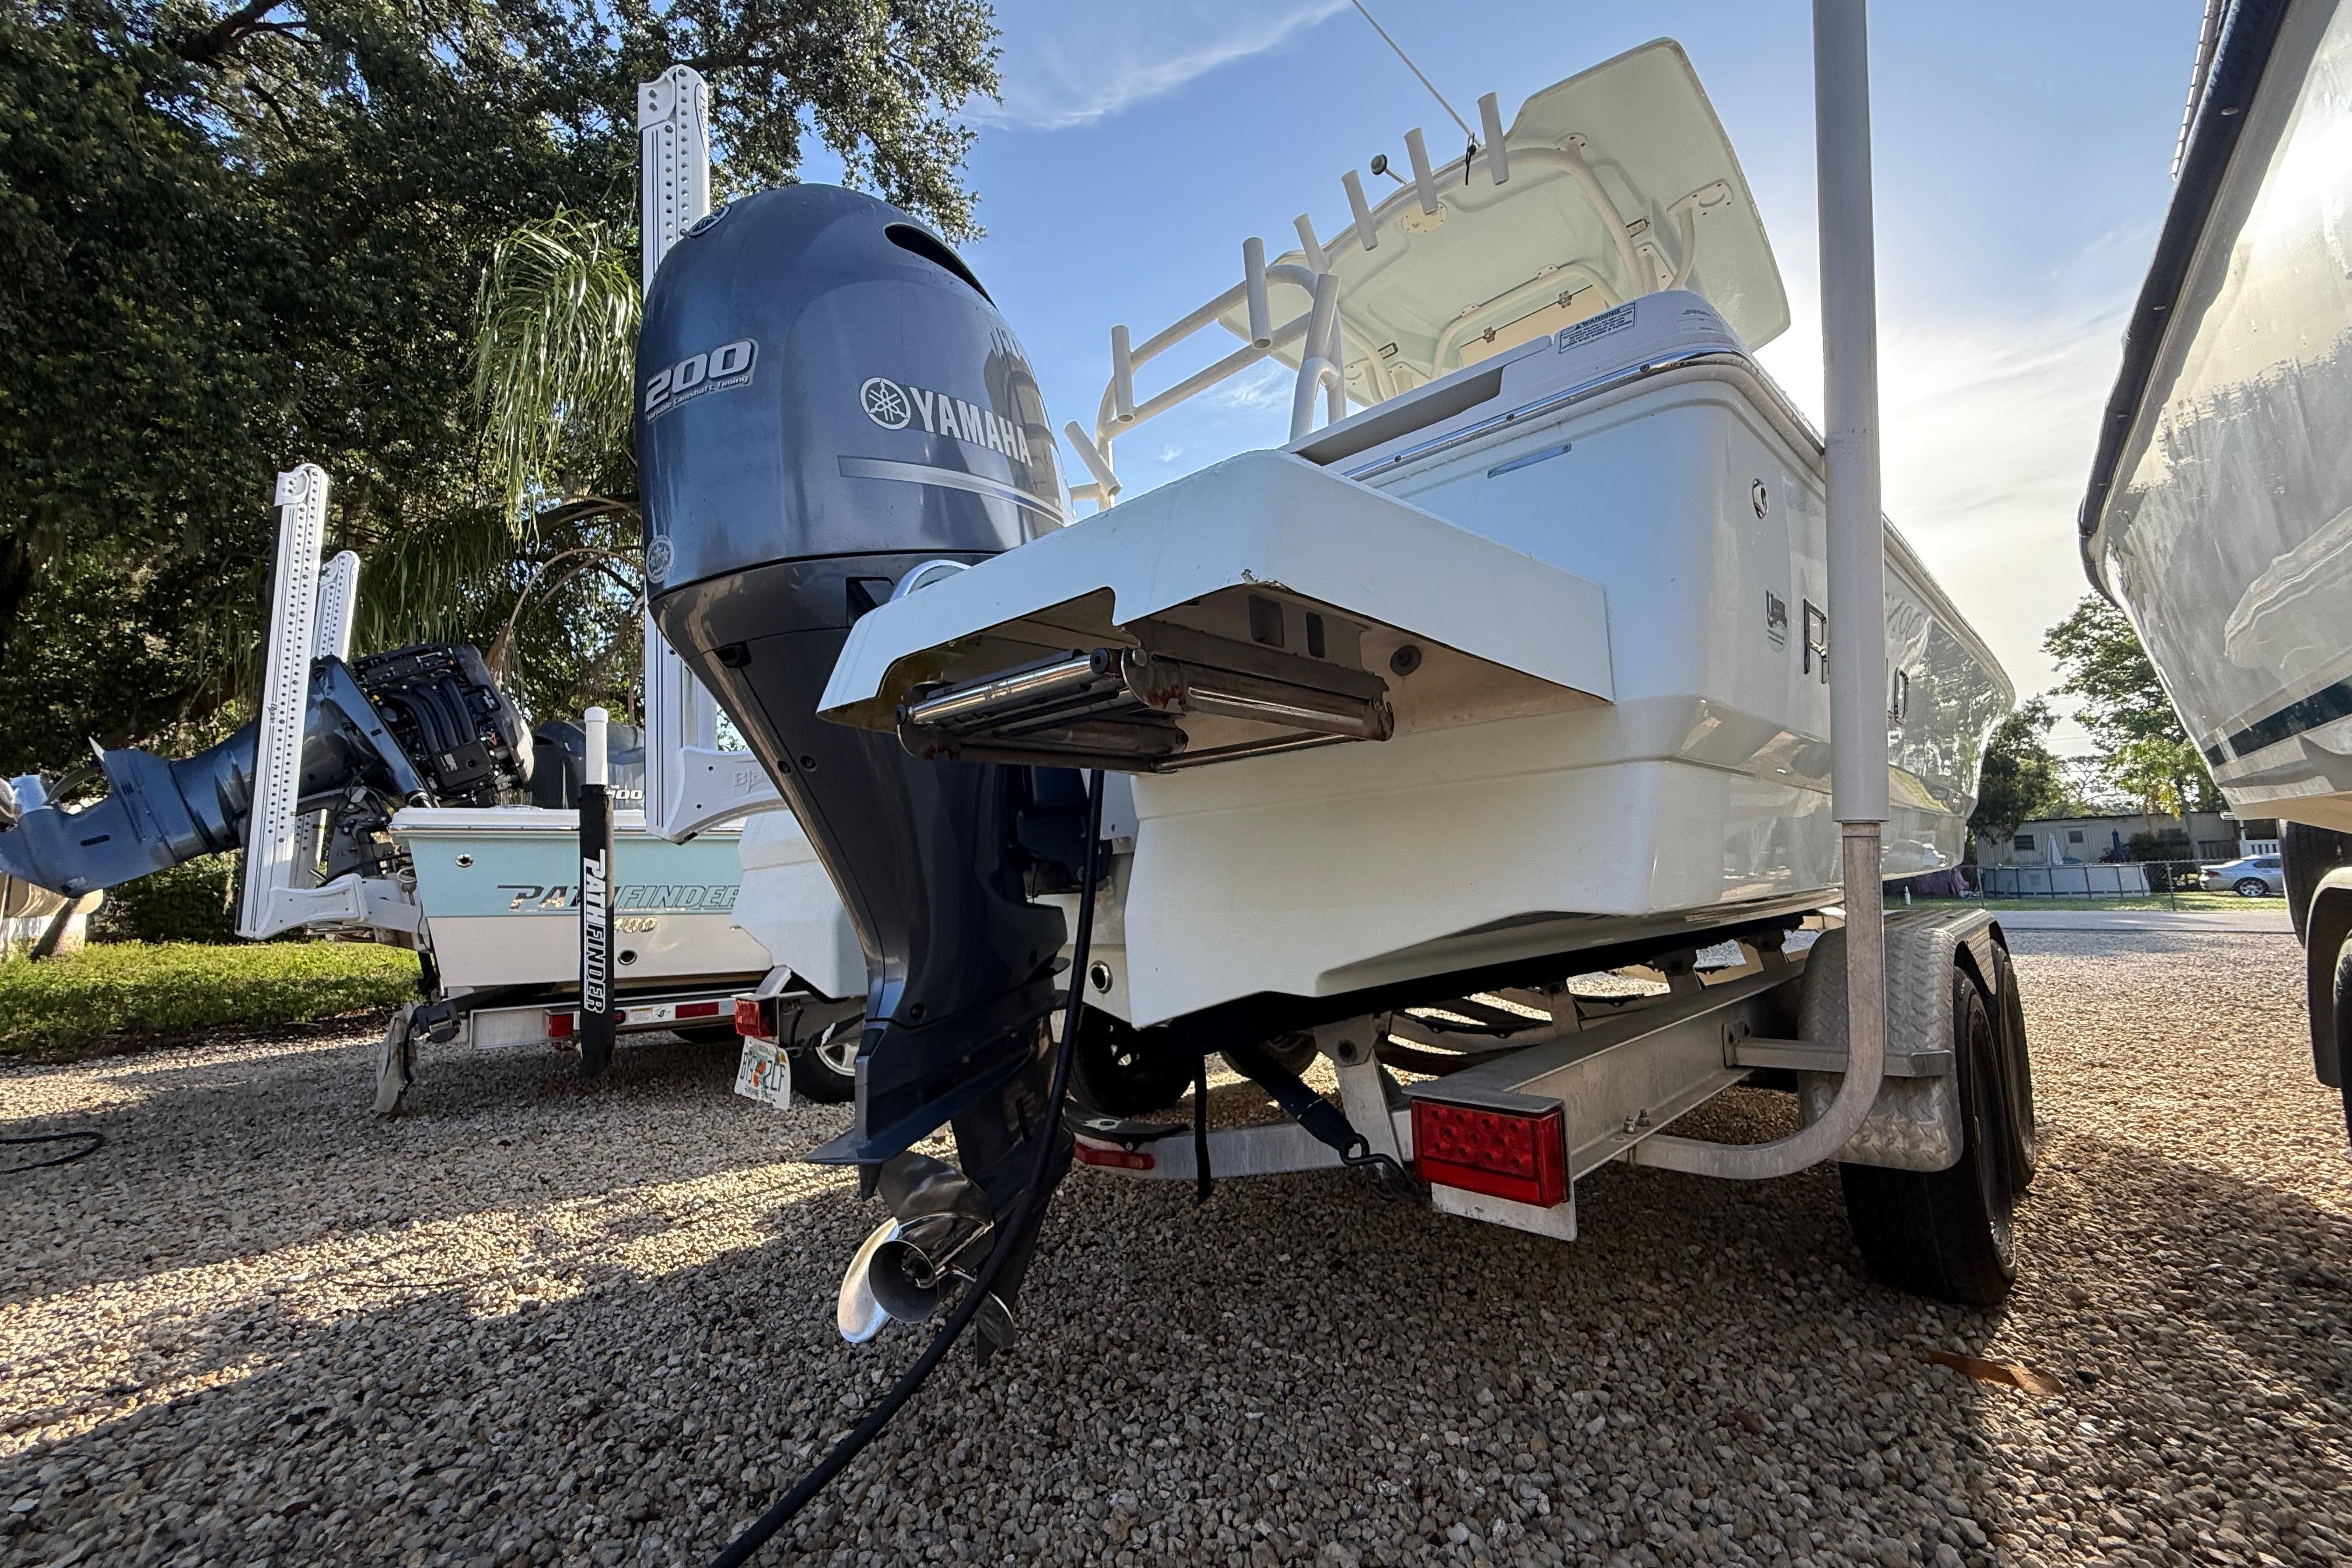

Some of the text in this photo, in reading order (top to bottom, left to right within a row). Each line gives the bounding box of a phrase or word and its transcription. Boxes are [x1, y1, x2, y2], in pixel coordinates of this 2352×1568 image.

[1583, 309, 1620, 327] WARNING
[645, 340, 754, 414] 200
[909, 386, 1034, 467] YAMAHA
[496, 885, 740, 909] PAFINDER
[583, 849, 606, 1014] PATHFINDER
